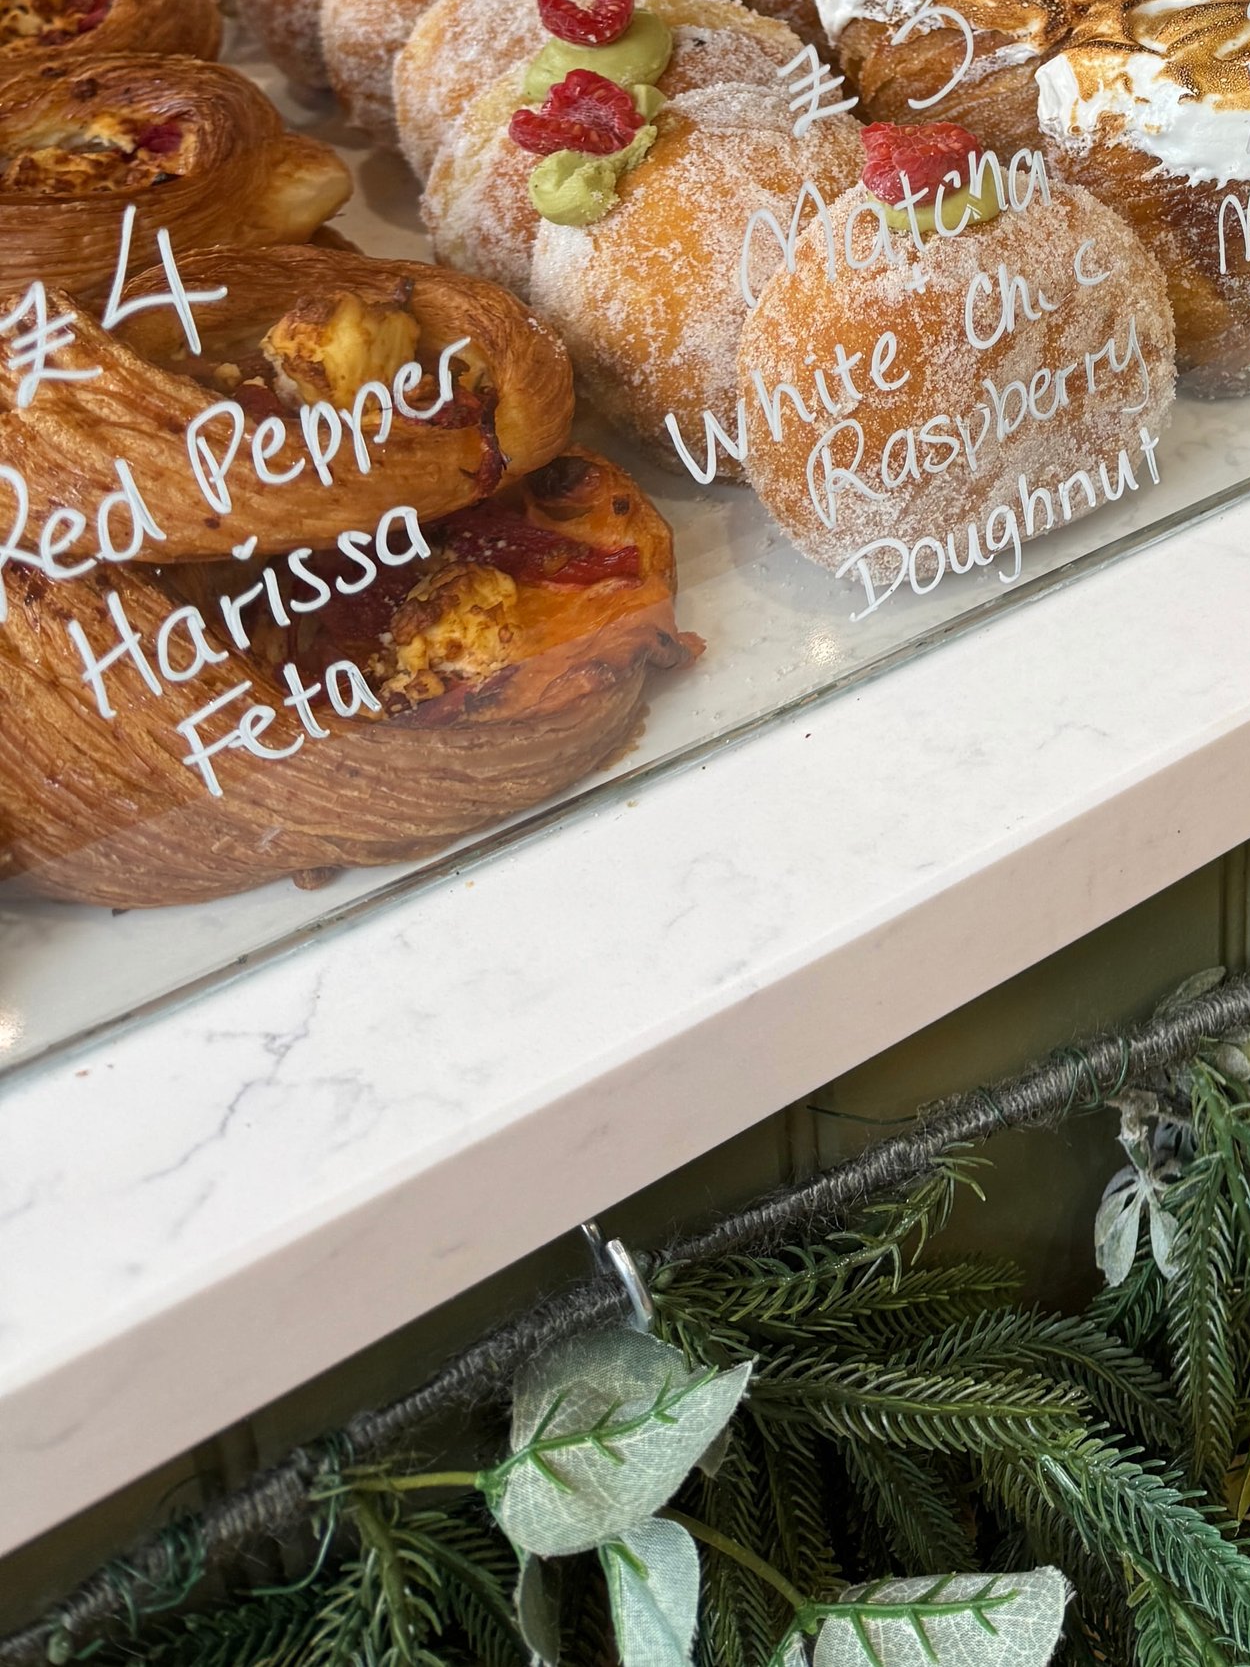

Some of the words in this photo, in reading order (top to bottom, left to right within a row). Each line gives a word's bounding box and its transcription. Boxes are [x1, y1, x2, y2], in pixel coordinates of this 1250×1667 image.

[0, 203, 229, 410] £4
[185, 334, 473, 516] Pepper
[663, 328, 911, 486] White
[804, 313, 1153, 531] Raspberry
[67, 504, 433, 721] Harissa
[832, 424, 1163, 624] Doughnut
[175, 658, 383, 799] Feta
